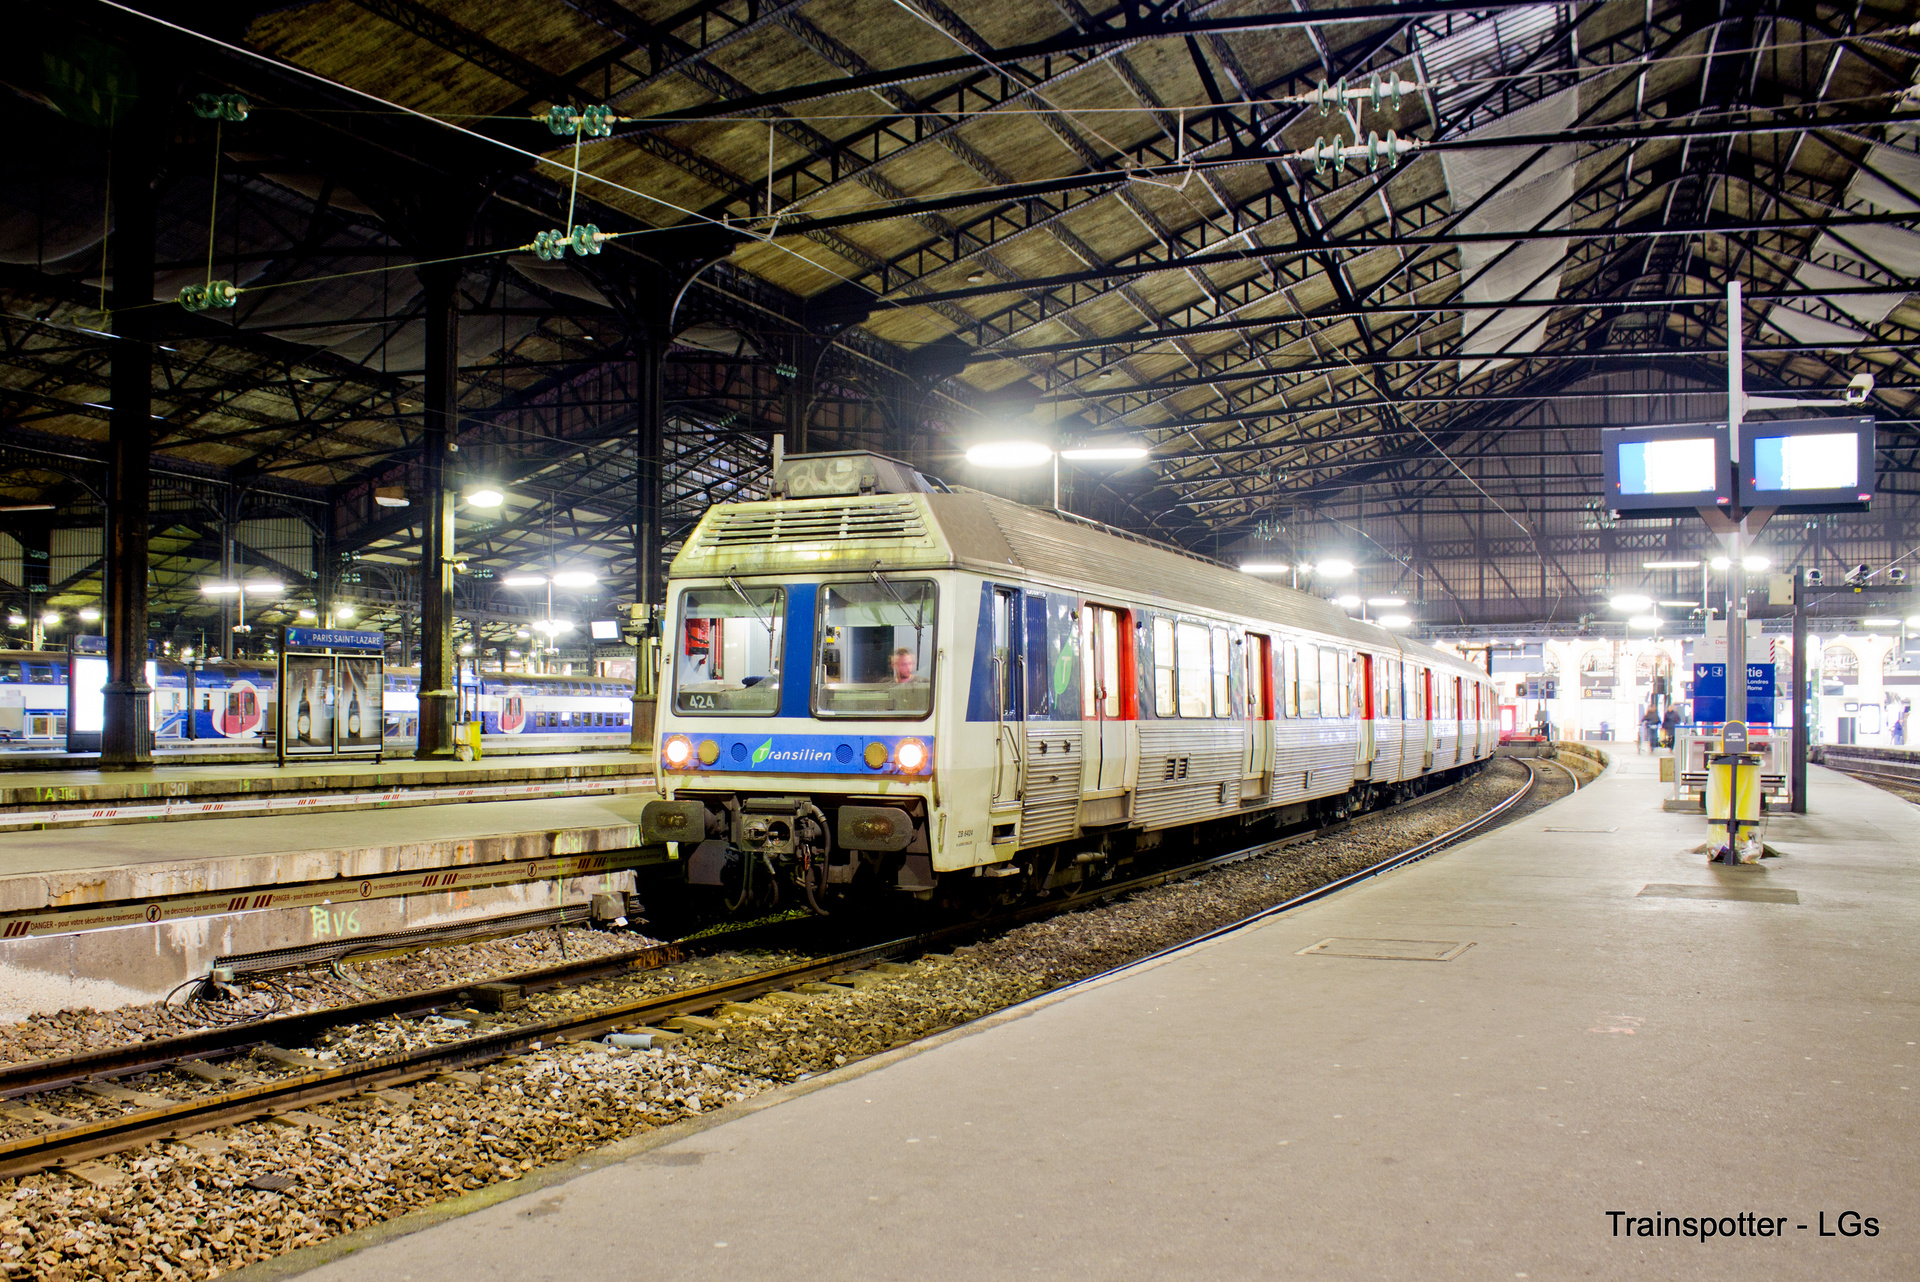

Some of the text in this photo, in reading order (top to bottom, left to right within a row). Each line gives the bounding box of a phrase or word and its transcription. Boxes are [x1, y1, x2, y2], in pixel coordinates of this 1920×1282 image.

[312, 633, 380, 645] PARIS SAINT-LAZARE
[1746, 666, 1763, 678] tie
[690, 695, 715, 709] 424
[759, 748, 832, 761] Transilien
[273, 893, 290, 902] DANGER
[30, 920, 54, 930] DANGER
[58, 920, 69, 928] pour
[70, 918, 84, 926] votre
[113, 913, 135, 921] traversez
[134, 912, 143, 921] pas
[171, 906, 193, 914] descendez
[194, 904, 202, 913] pas
